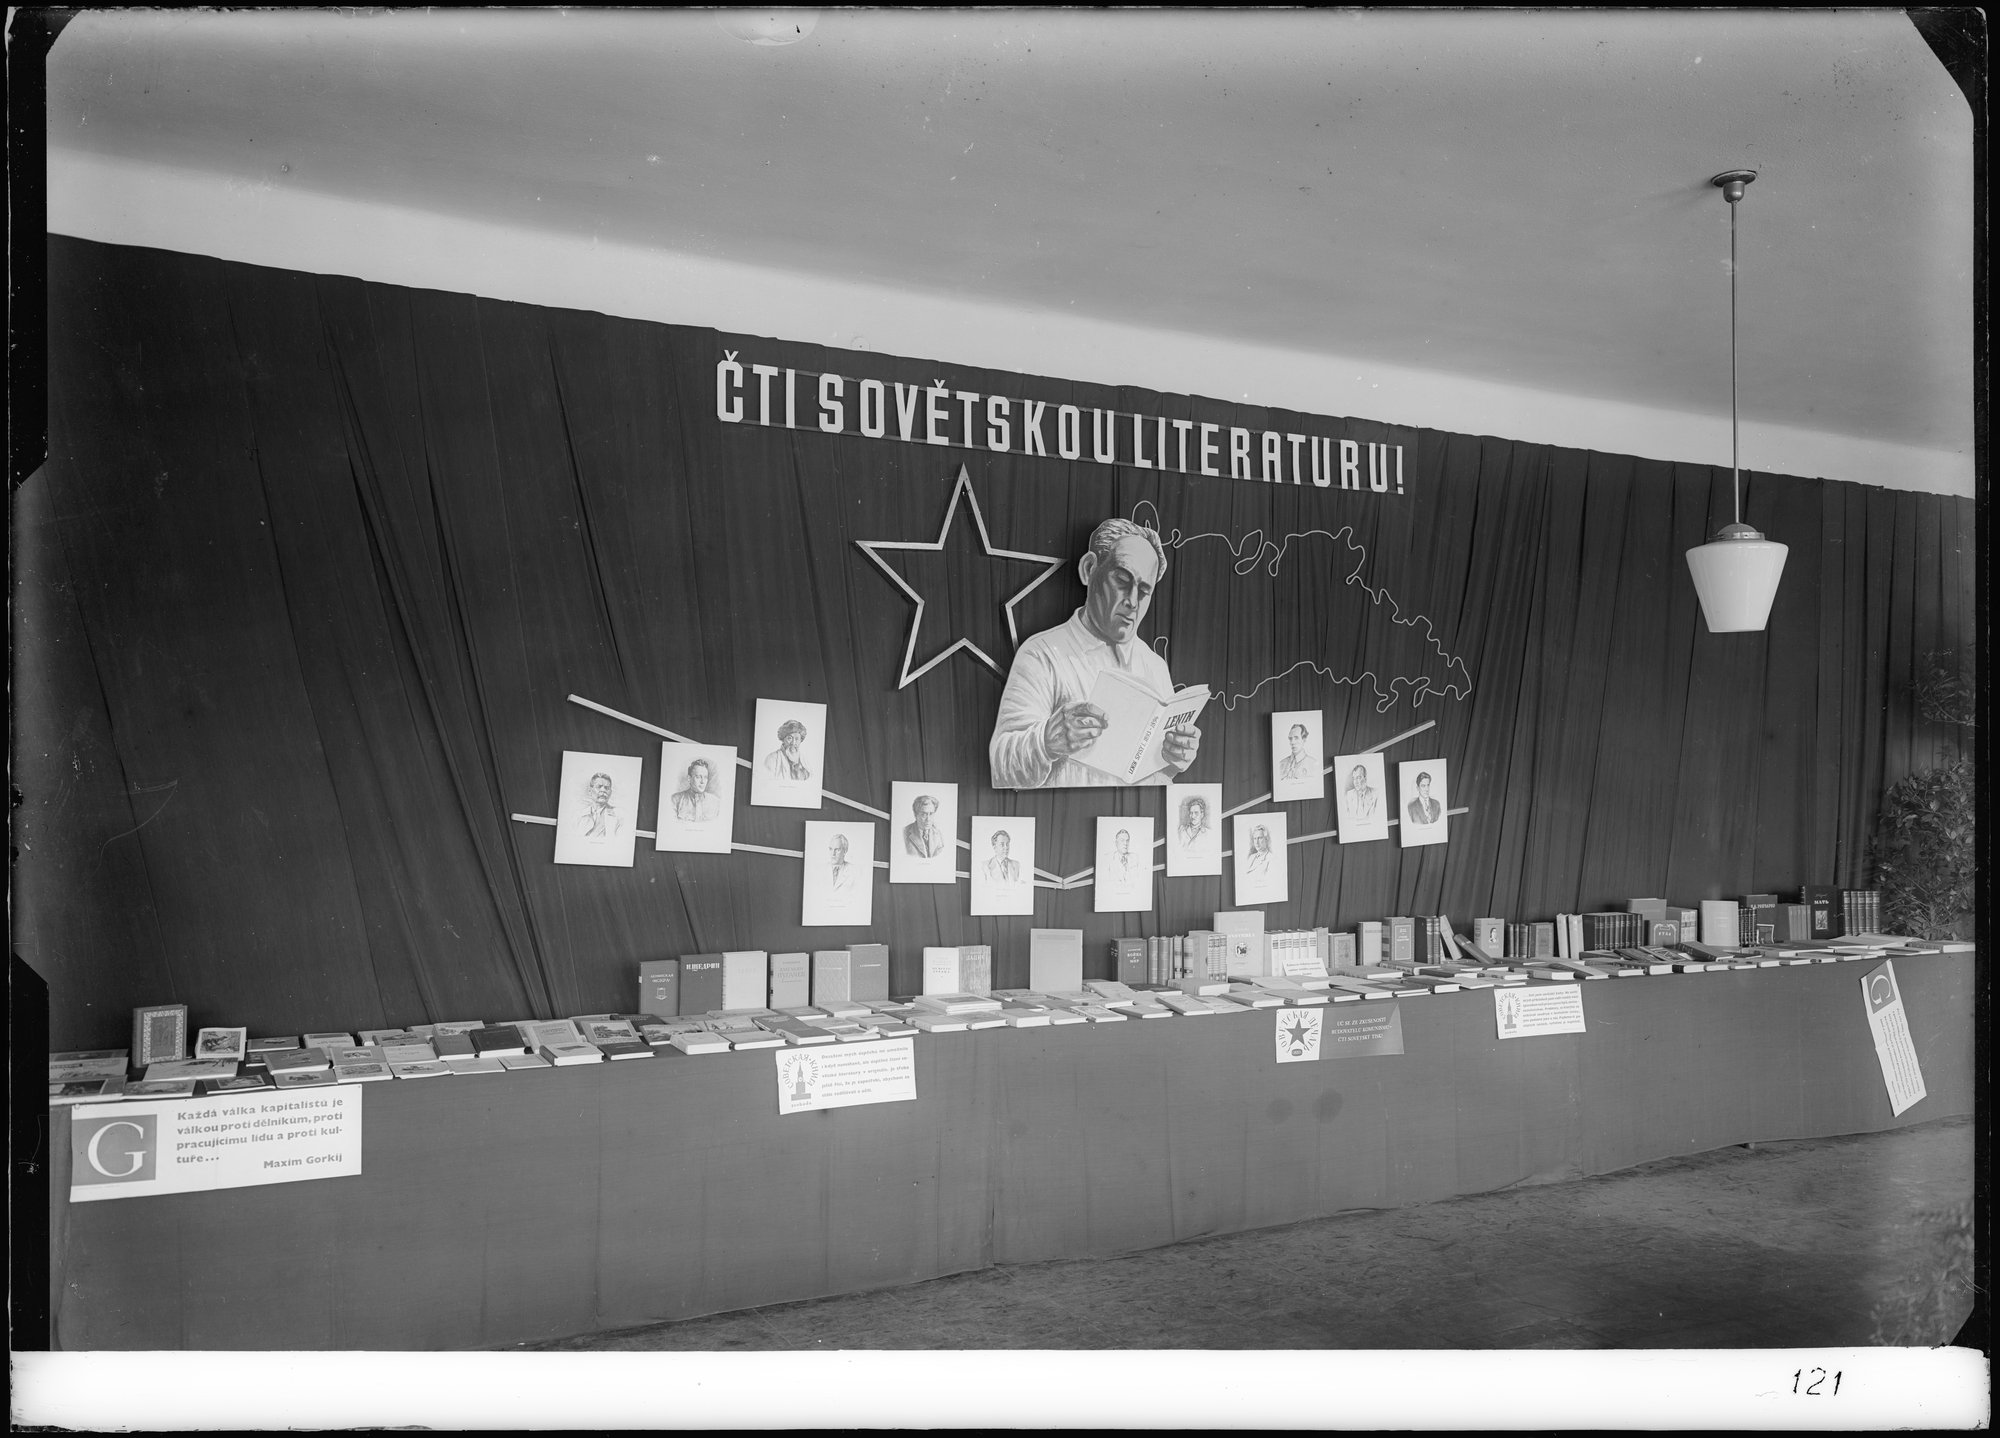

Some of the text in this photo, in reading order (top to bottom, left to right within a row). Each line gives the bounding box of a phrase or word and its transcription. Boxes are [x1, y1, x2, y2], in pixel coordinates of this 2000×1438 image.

[717, 350, 1404, 495] ČTI SOVĚTSKOU LITERATURU!
[1163, 710, 1196, 730] LENIN
[177, 1098, 343, 1120] Každá válka kapitalistů je
[177, 1112, 343, 1135] válkou proti dělníkům, proti
[88, 1121, 147, 1177] G
[176, 1126, 343, 1151] pracujícímu lidu a proti kul-
[263, 1153, 343, 1169] Maxim Gorkij
[1793, 1367, 1842, 1396] 121
